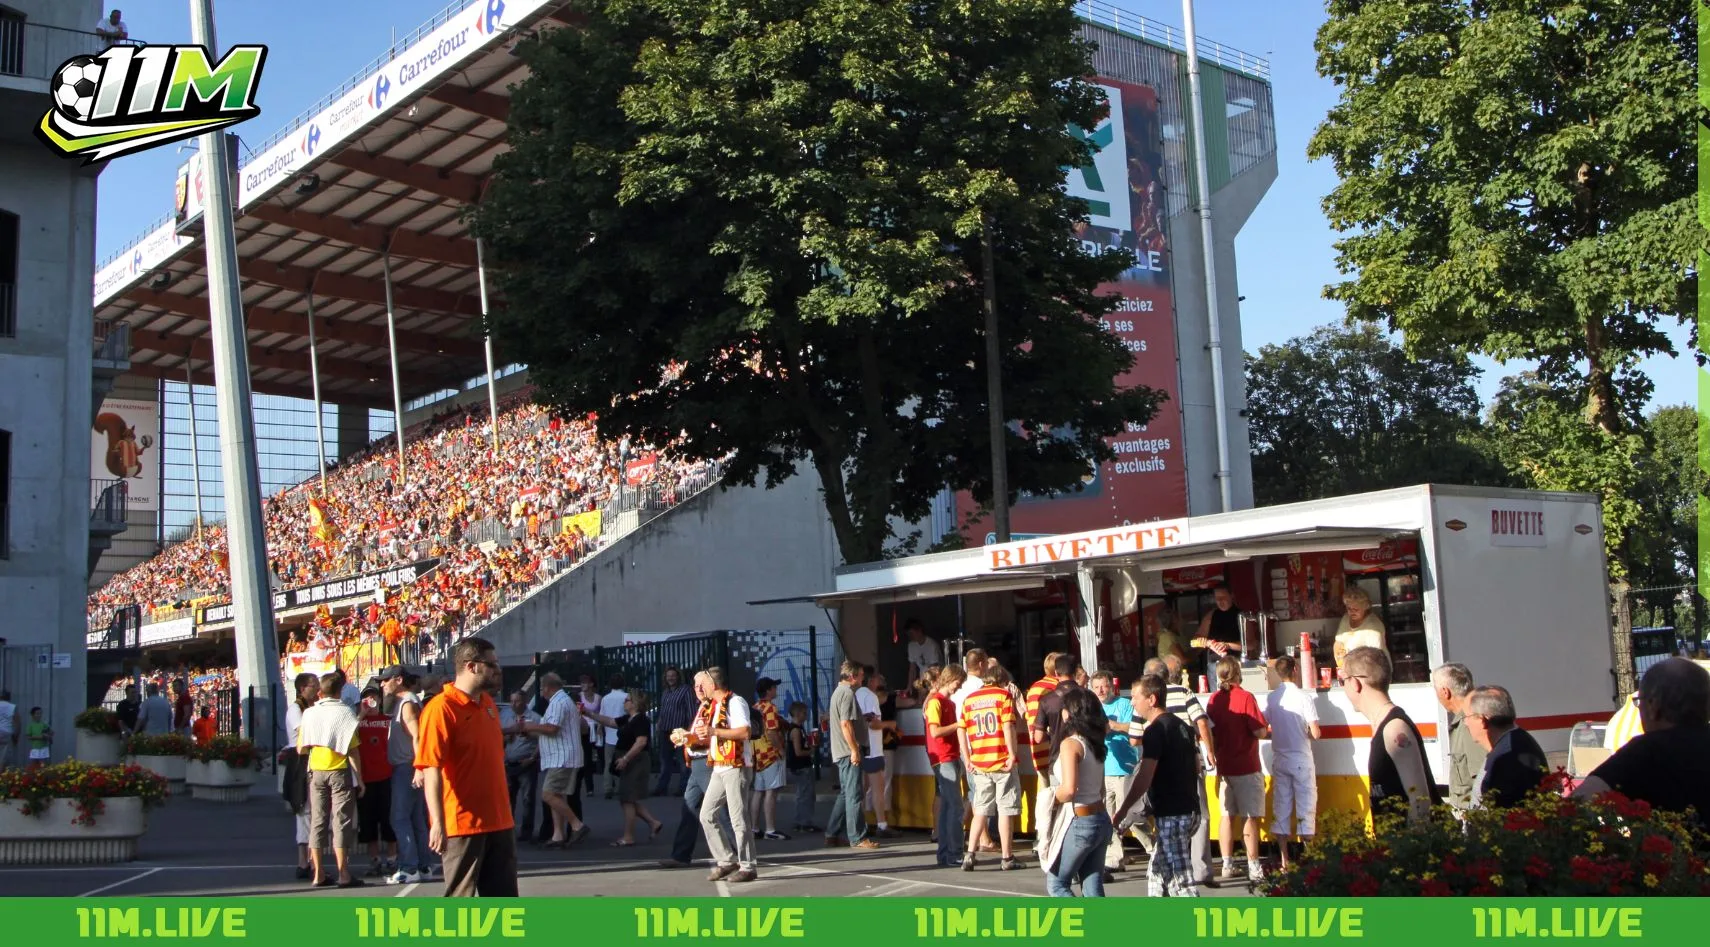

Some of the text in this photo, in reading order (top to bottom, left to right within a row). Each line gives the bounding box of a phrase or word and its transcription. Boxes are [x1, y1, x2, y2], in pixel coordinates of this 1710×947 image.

[399, 27, 469, 86] Carrefour
[329, 94, 365, 126] Carrefour
[246, 148, 297, 192] Carrefour
[1114, 320, 1134, 332] ses
[1112, 438, 1171, 454] avantages
[1115, 456, 1166, 474] exclusifs
[1491, 510, 1544, 535] BUVETTE
[990, 525, 1181, 569] BUVETTE
[296, 590, 311, 605] TOUS
[312, 587, 326, 602] UNIS
[327, 582, 342, 599] SOUS
[344, 579, 356, 595] LES
[357, 574, 380, 592] MÊMES
[973, 711, 998, 736] 10
